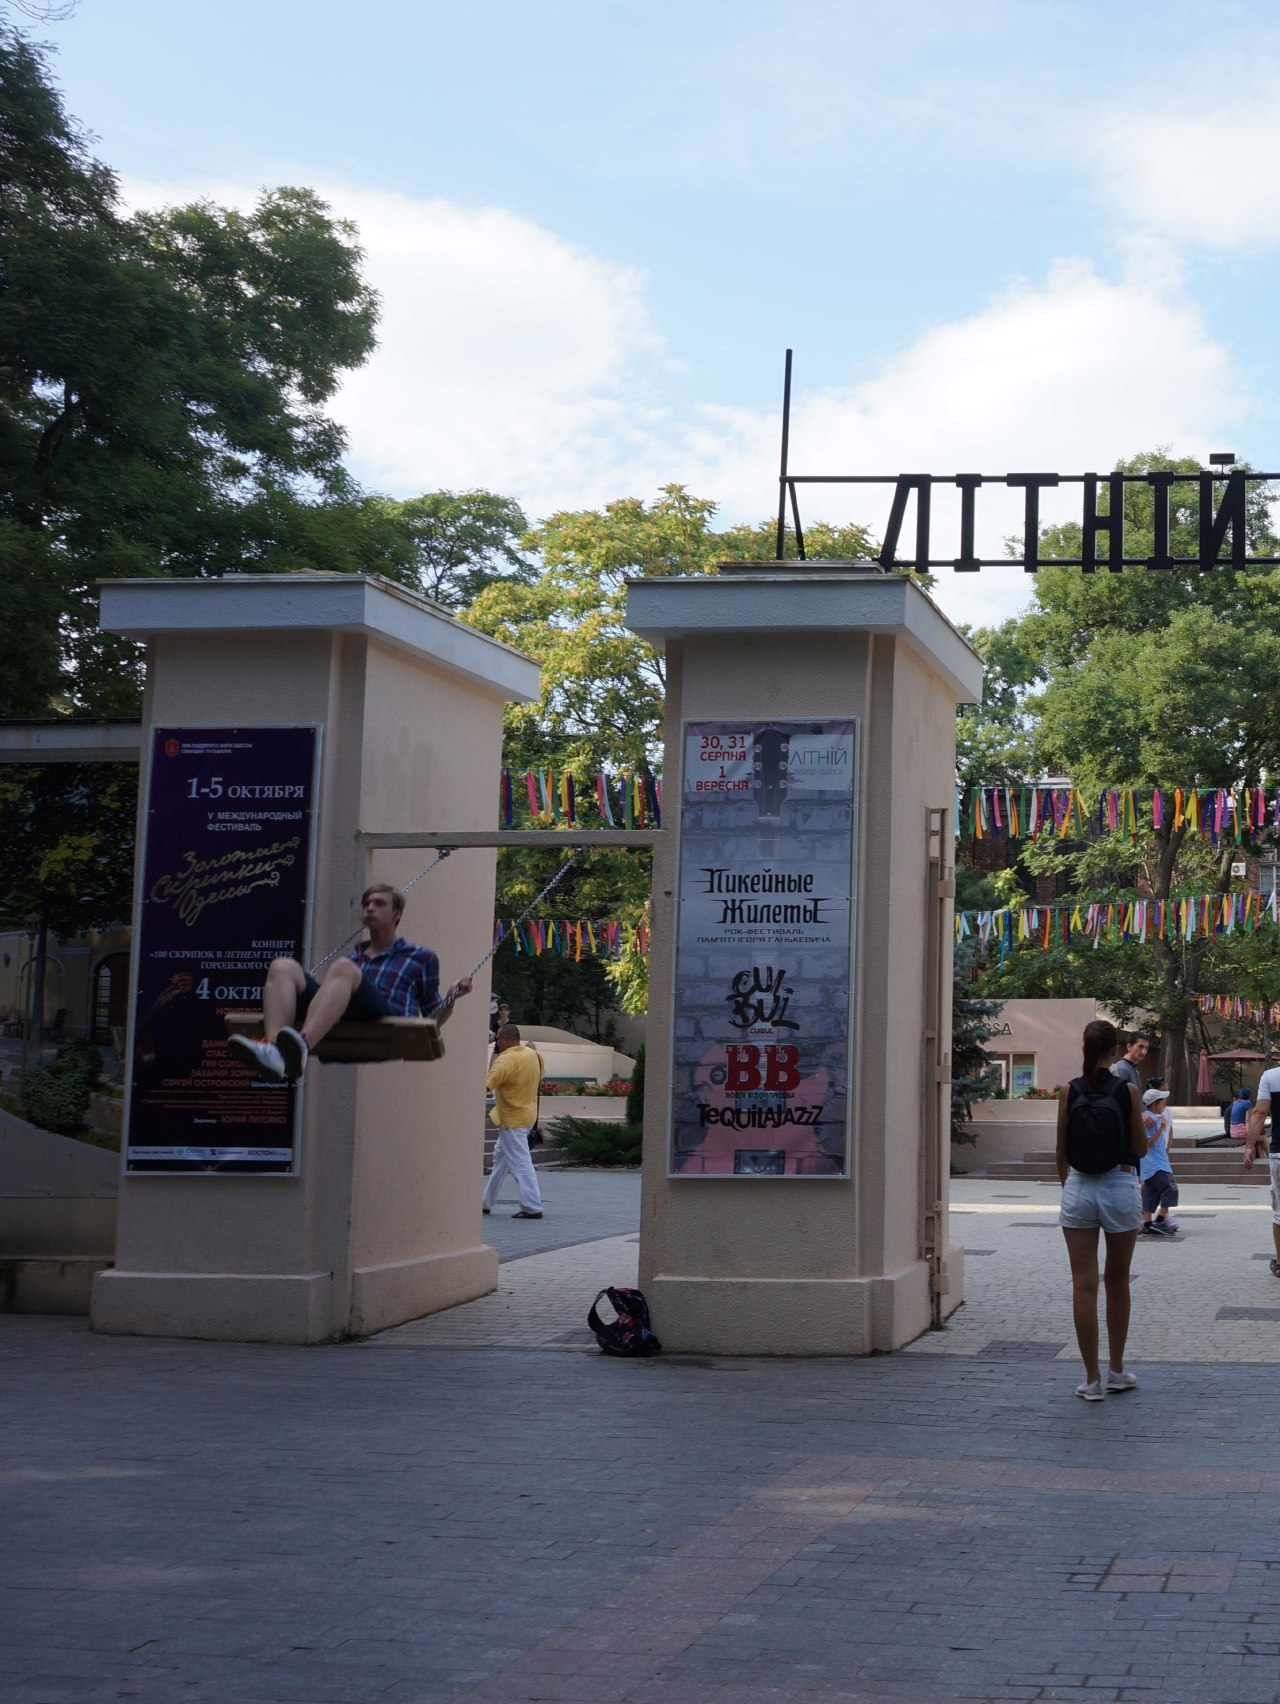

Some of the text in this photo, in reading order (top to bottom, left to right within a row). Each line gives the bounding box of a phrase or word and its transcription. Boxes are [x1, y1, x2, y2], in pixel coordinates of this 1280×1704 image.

[880, 453, 1247, 572] ЛІТНІЙ
[700, 735, 746, 750] 30, 31
[700, 751, 746, 762] СЕРПНЯ
[718, 766, 727, 779] 1
[187, 777, 304, 799] 1-5 ОКТЯБРЯ
[695, 780, 749, 791] ВЕРЕСНЯ
[217, 810, 302, 821] МЕЖДУНАРОДНЫЙ
[207, 823, 262, 831] ФЕСТИВАЛЬ
[692, 868, 813, 893] Пикейные
[252, 940, 296, 949] КОНЦЕРТ
[201, 961, 262, 970] ГОРОДСКОГО
[195, 977, 211, 999] 4
